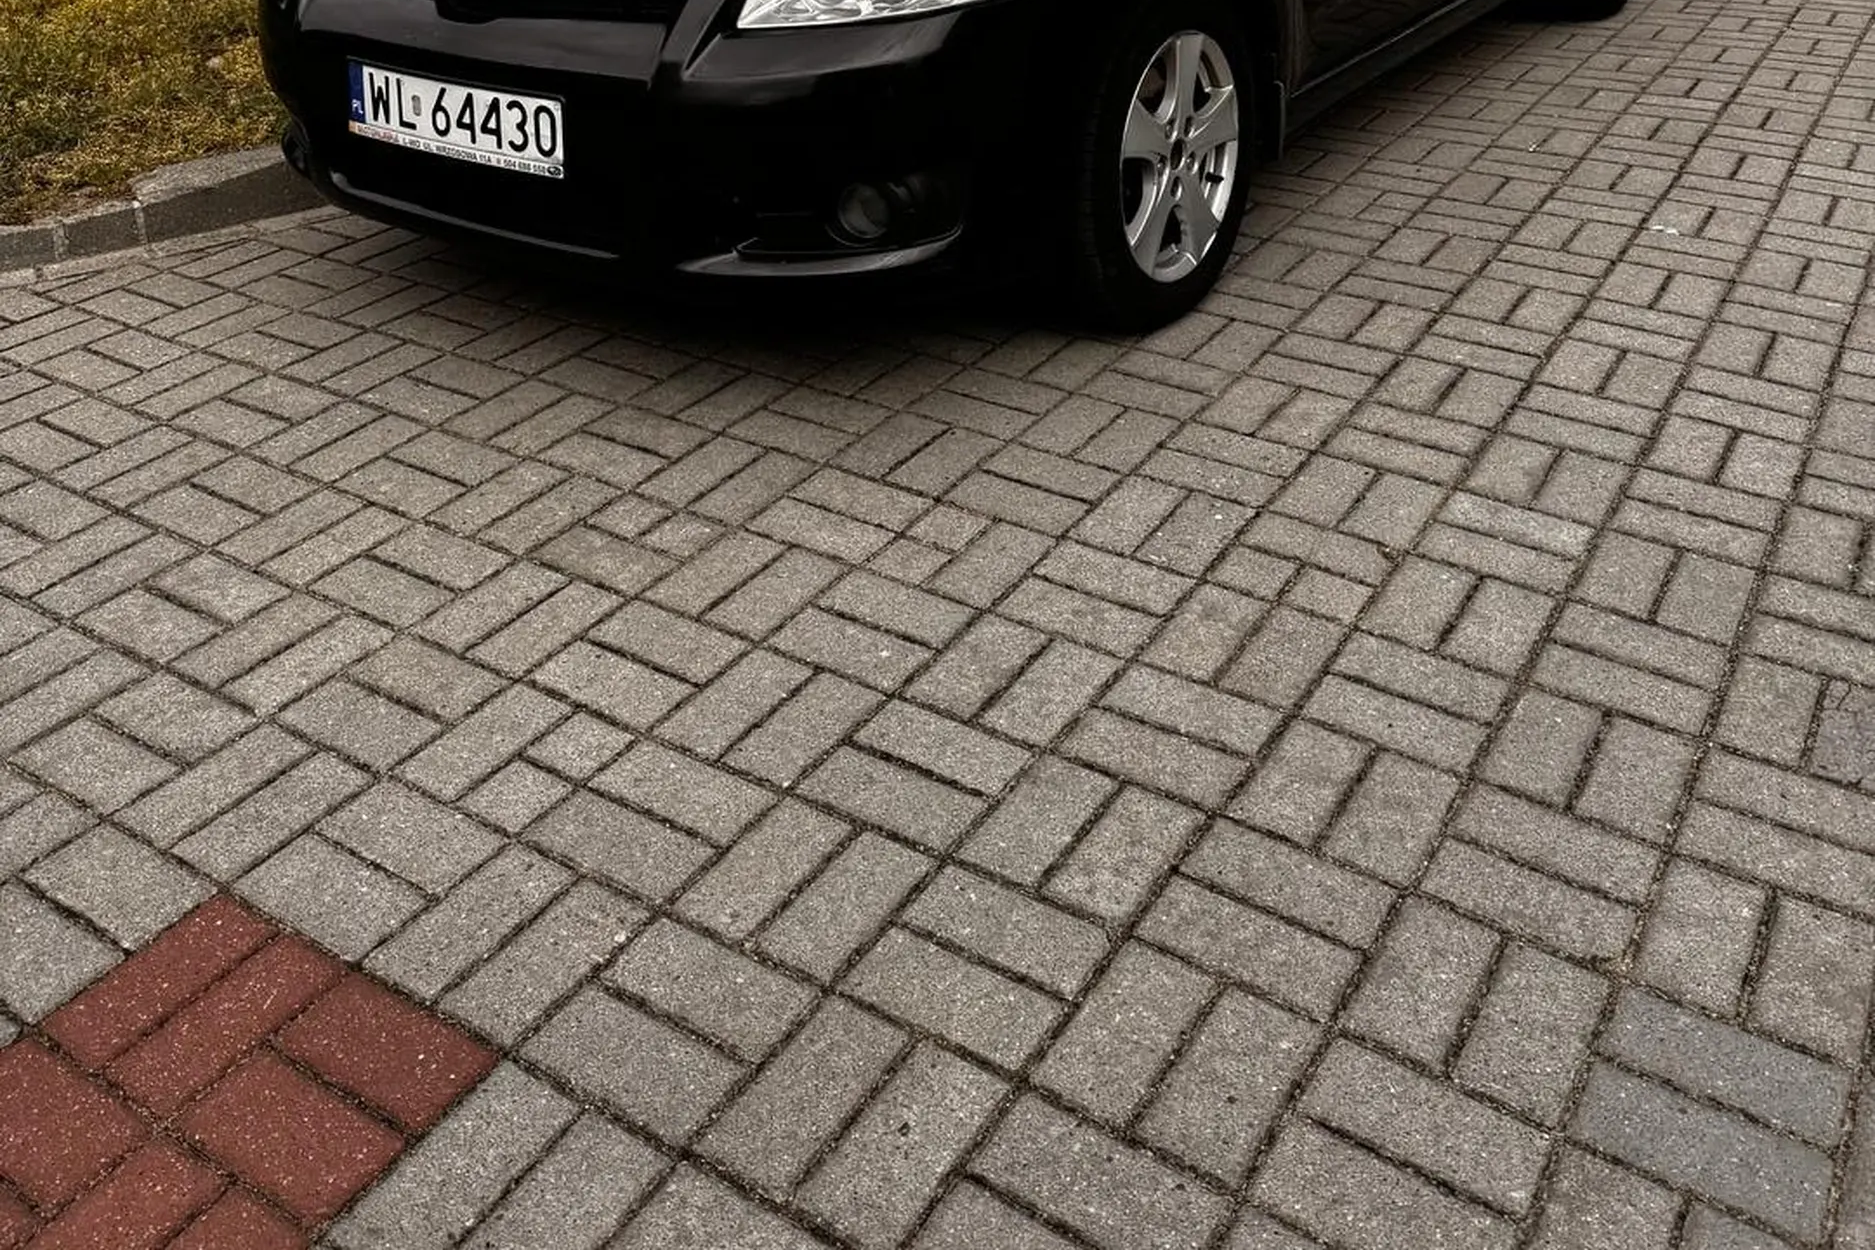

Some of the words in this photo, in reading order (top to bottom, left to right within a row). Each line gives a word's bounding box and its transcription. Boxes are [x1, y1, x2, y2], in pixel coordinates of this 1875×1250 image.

[352, 99, 364, 114] PL
[369, 72, 417, 130] WL
[431, 87, 557, 158] 64430
